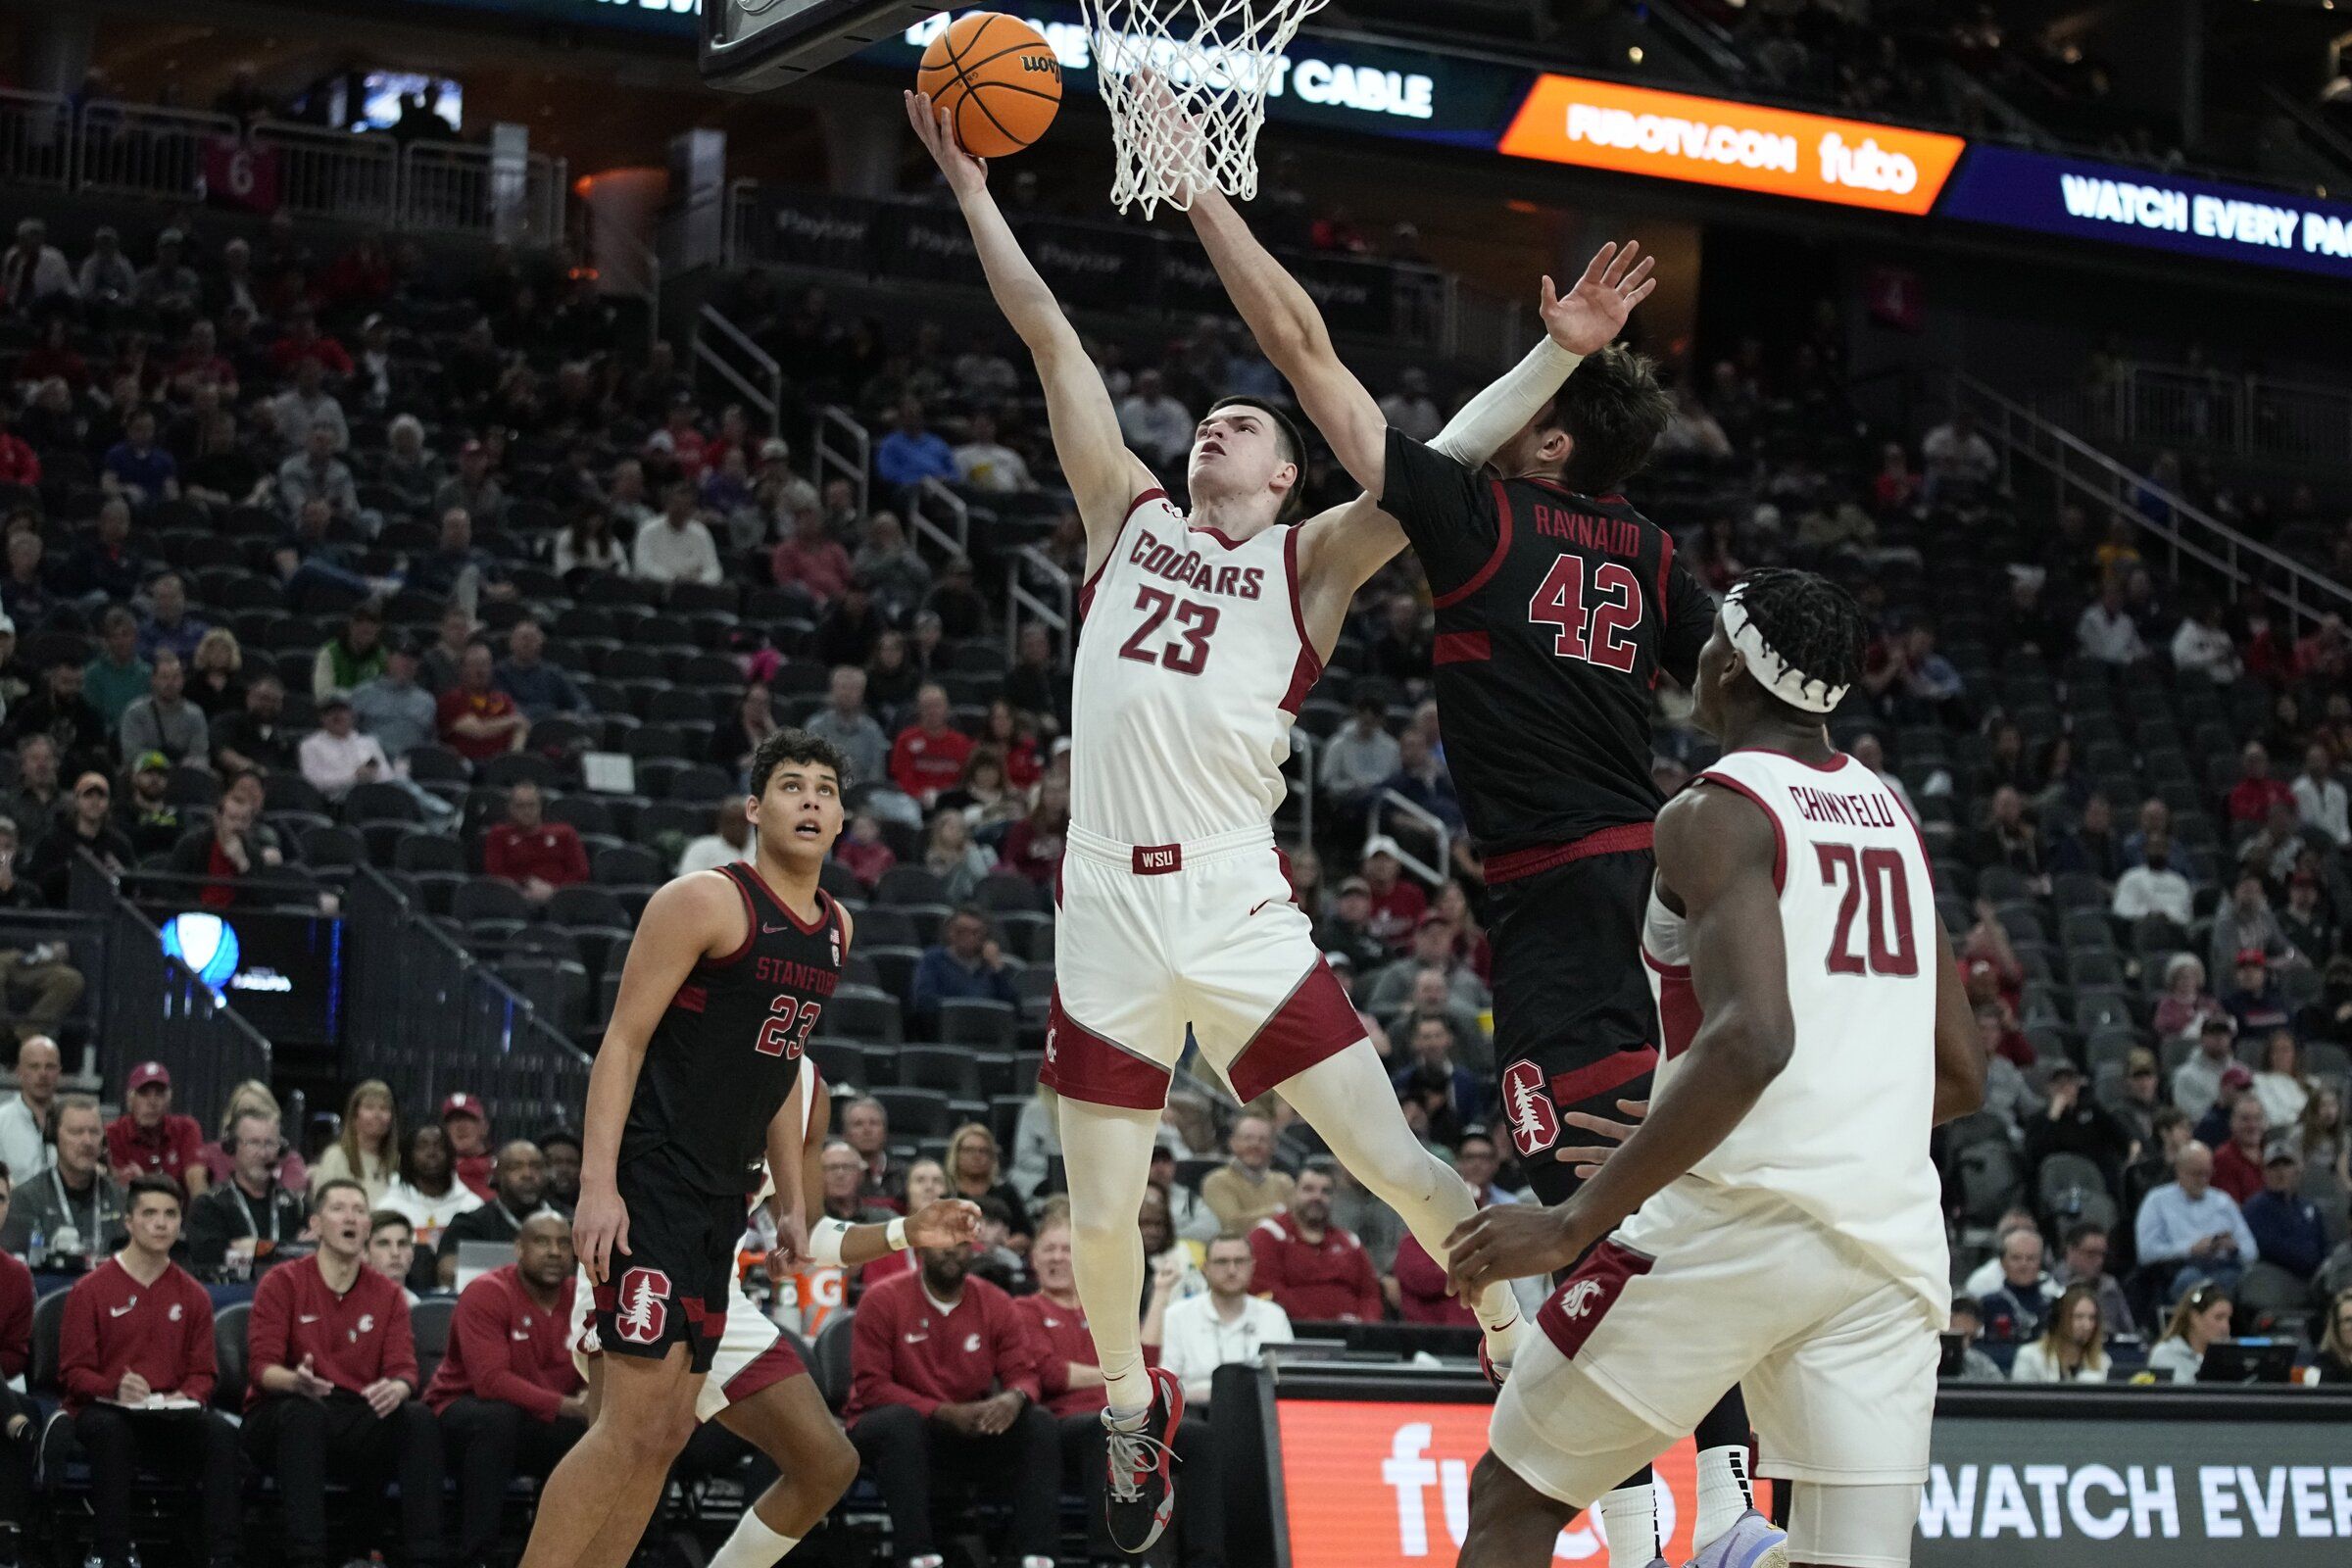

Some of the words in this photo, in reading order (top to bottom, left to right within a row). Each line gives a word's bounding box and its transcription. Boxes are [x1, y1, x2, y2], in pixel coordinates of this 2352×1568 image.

[1293, 59, 1434, 119] CABLE
[229, 150, 255, 196] 6
[1567, 103, 1798, 173] FUBOTV.COM
[1818, 131, 1918, 195] fubo
[2060, 172, 2188, 233] WATCH
[2192, 194, 2299, 249] EVERY
[1129, 528, 1265, 602] COUGARS
[1533, 503, 1641, 559] RAYNAUD
[1118, 582, 1221, 677] 23
[1528, 553, 1643, 674] 42
[1788, 785, 1896, 828] CHINYELU
[1142, 850, 1174, 868] WSU
[1809, 839, 1920, 979] 20
[755, 994, 822, 1060] 23
[812, 1269, 843, 1306] G
[1918, 1463, 2181, 1541] WATCH
